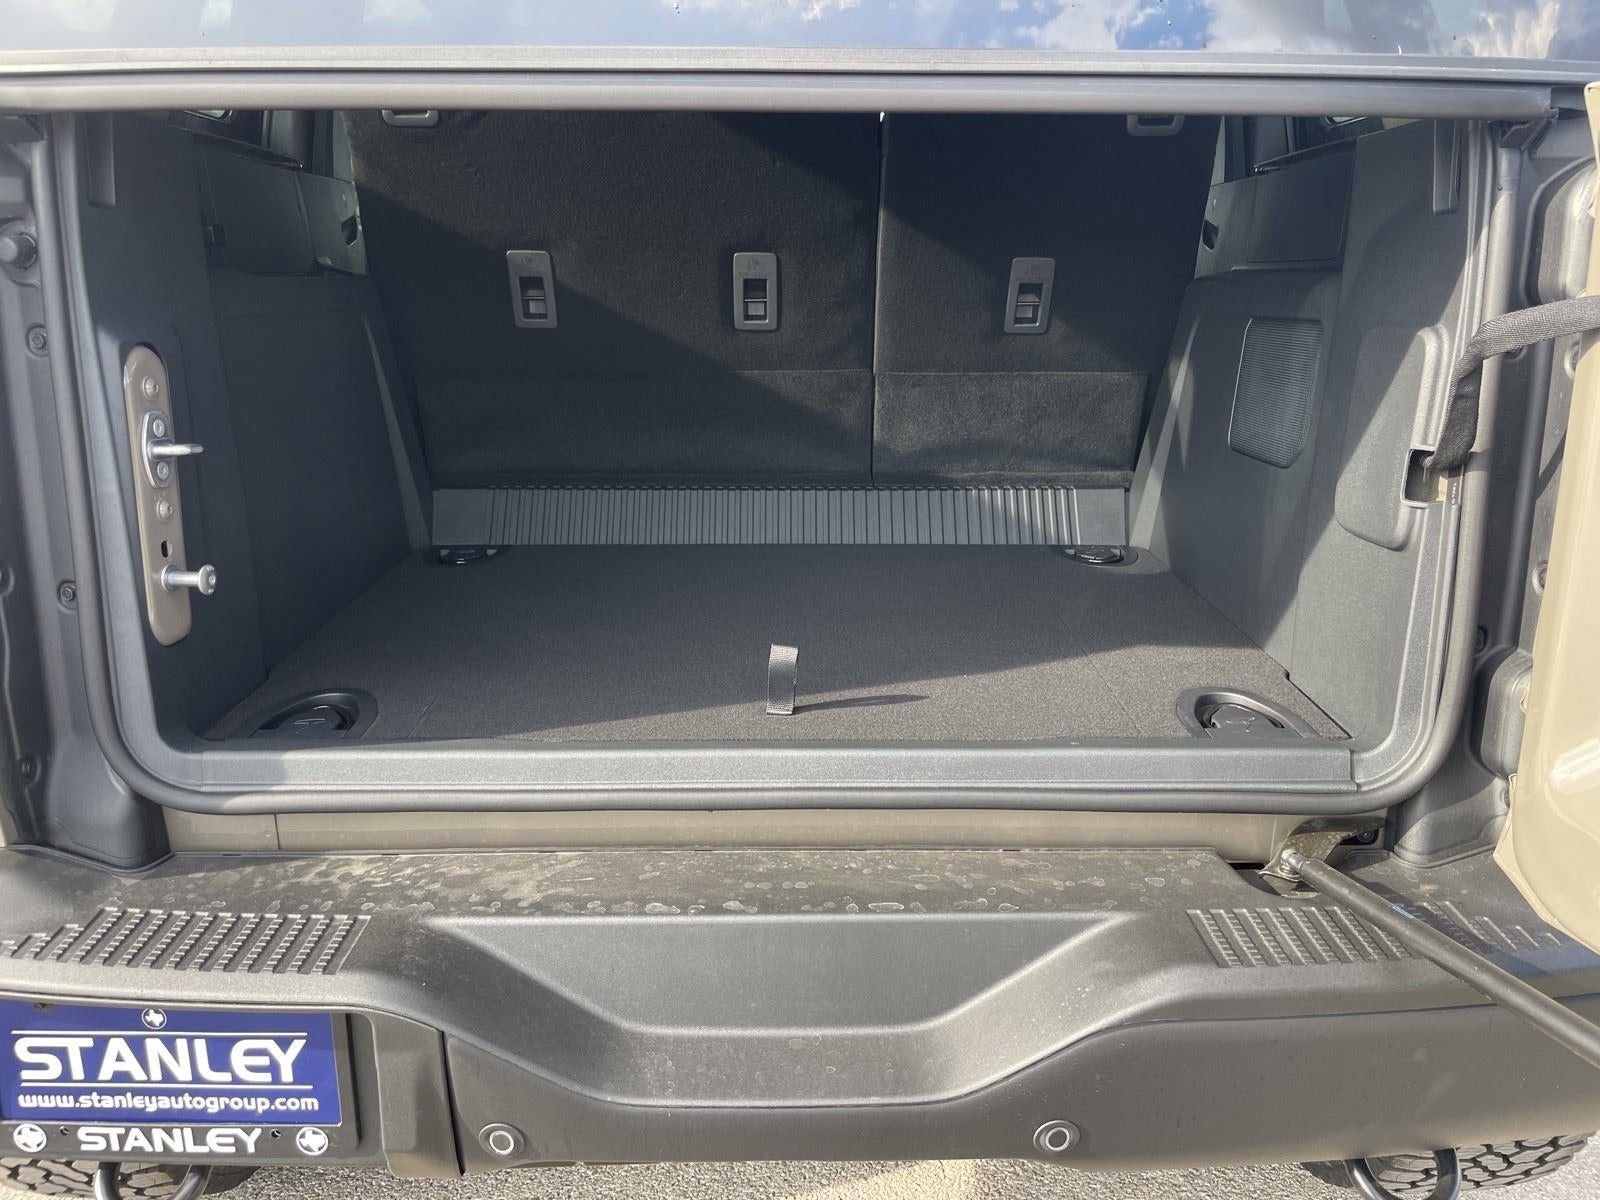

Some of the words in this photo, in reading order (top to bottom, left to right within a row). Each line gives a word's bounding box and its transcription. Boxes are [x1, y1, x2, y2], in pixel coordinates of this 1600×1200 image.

[14, 1037, 307, 1082] STANLEY
[18, 1092, 319, 1113] www.stanleyautogroup.com
[77, 1127, 263, 1153] STANLEY
